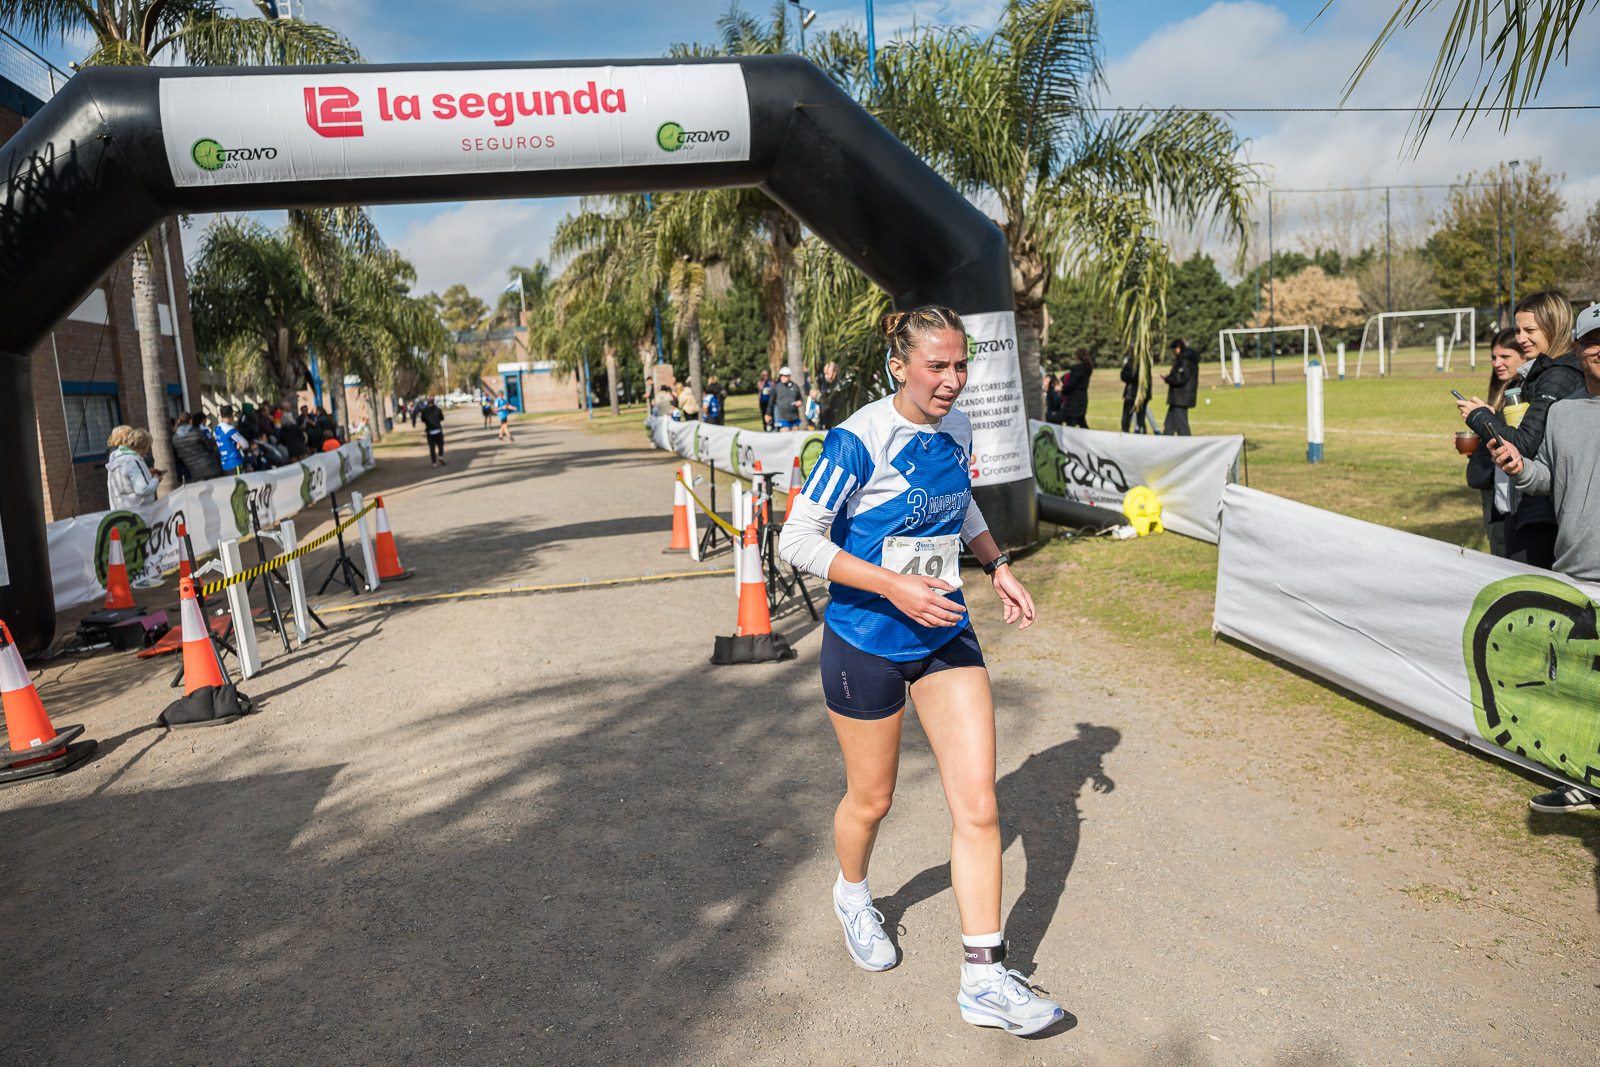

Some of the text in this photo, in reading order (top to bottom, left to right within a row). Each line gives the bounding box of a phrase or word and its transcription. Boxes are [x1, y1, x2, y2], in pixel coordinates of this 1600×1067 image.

[377, 81, 627, 127] la segunda
[462, 135, 556, 151] SEGUROS
[677, 130, 730, 143] CRONO
[216, 148, 278, 162] CRONO
[217, 162, 239, 170] RAV
[969, 338, 1014, 355] CRONO
[1003, 405, 1010, 414] DE
[972, 418, 1013, 431] ORREDORES"
[904, 488, 928, 529] 3
[900, 554, 944, 579] 49
